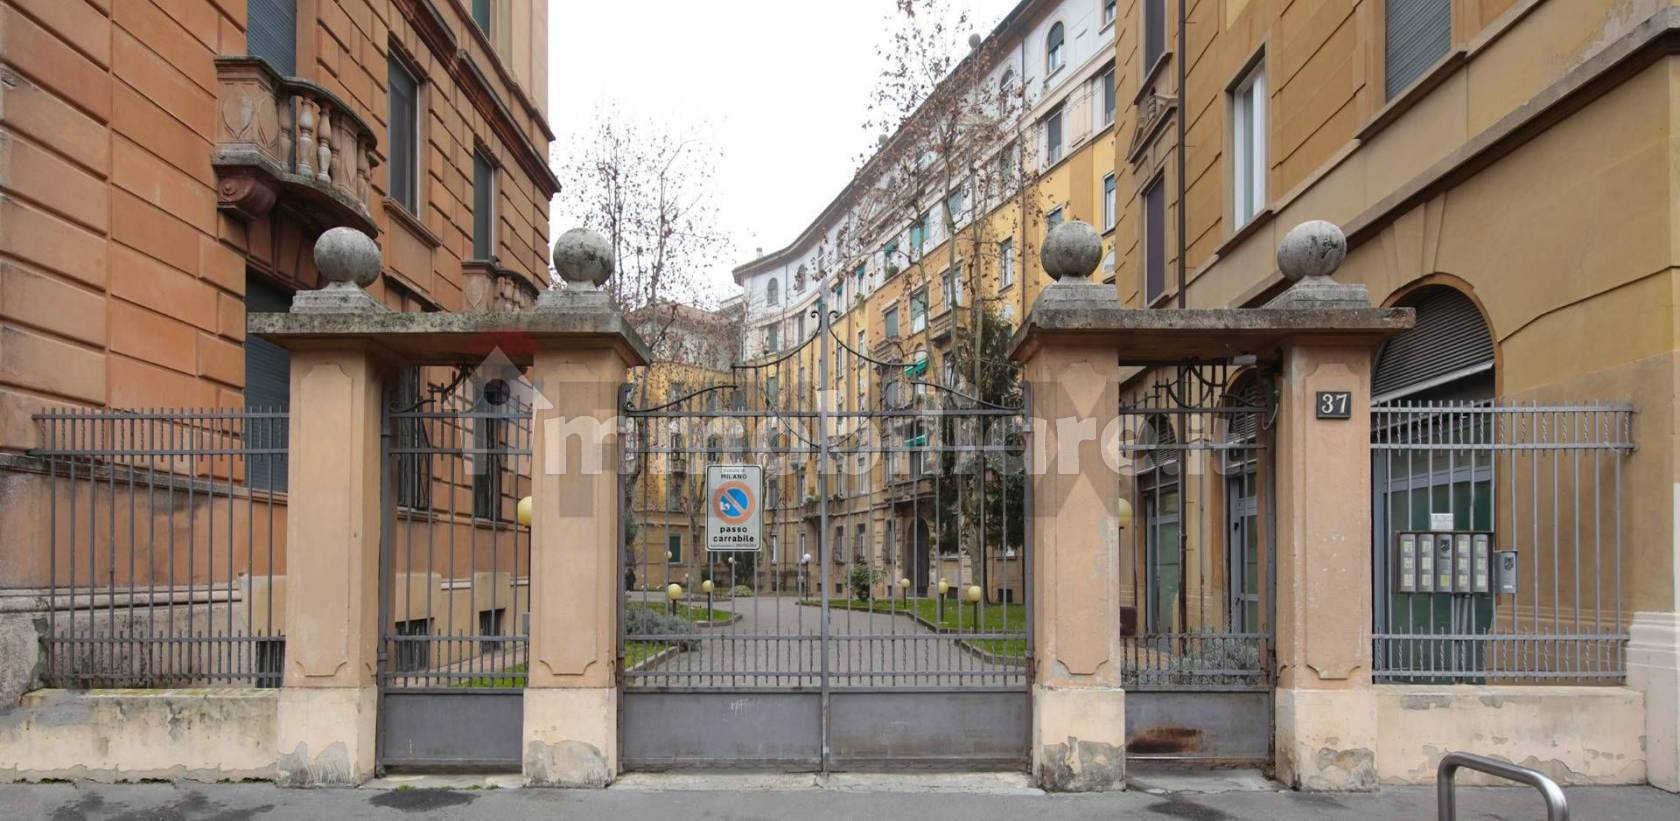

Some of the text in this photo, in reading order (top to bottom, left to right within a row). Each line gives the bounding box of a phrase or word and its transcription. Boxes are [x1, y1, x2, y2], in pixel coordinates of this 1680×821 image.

[1321, 393, 1348, 414] 37
[719, 526, 748, 534] passo
[713, 535, 755, 543] carrabile
